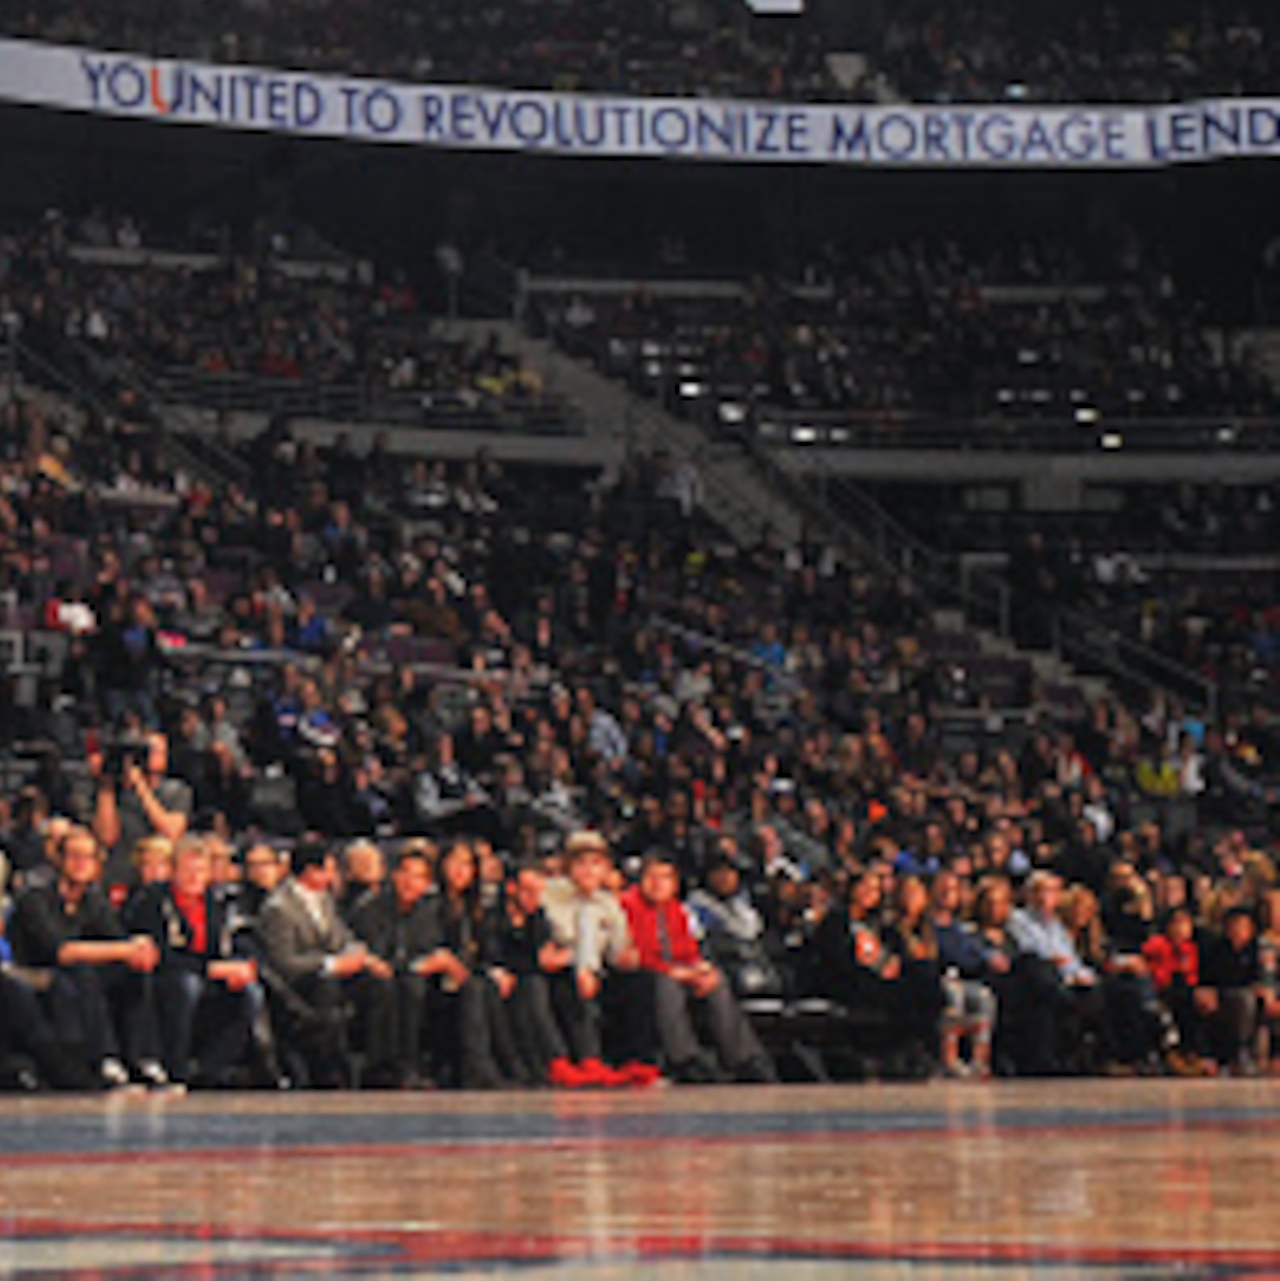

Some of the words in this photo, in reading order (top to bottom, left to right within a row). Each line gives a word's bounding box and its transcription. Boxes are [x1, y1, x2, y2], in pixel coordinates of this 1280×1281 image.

[79, 56, 323, 130] YOUNITED
[340, 84, 403, 135] TO
[421, 93, 808, 154] REVOLUTIONIZE
[831, 111, 1126, 162] MORTGAGE
